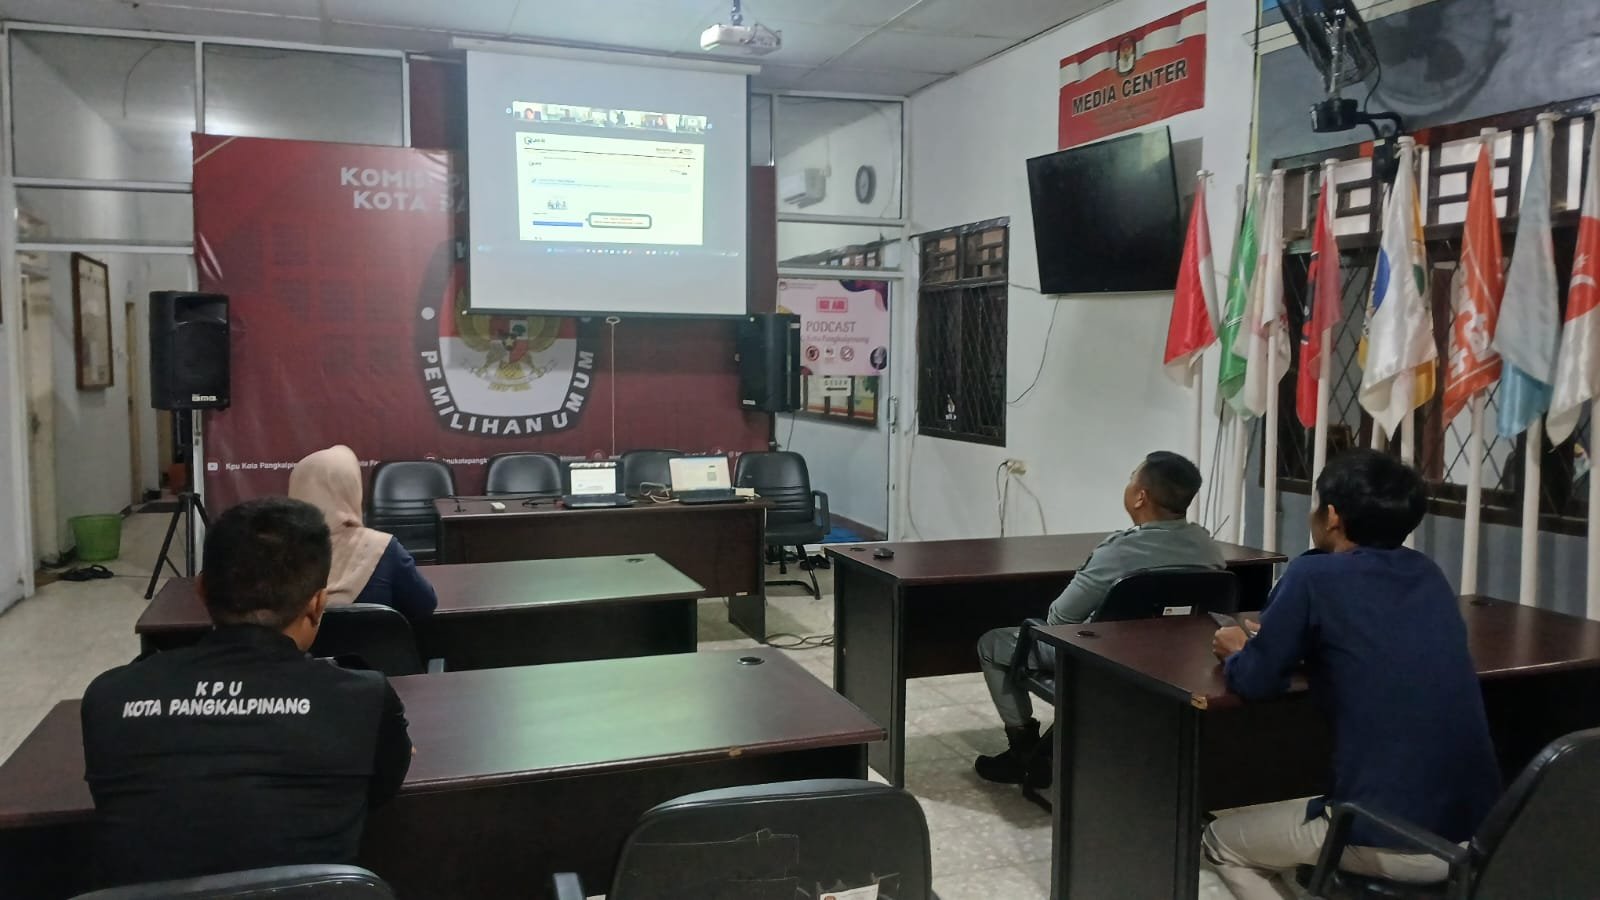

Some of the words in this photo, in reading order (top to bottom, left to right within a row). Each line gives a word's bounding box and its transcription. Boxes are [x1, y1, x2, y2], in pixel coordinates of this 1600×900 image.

[1072, 85, 1117, 117] MEDIA
[1122, 58, 1188, 98] CENTER
[353, 190, 427, 212] KOTA
[805, 321, 857, 333] PODCAST
[421, 350, 543, 435] PEMILIHAN
[551, 350, 595, 429] UMUM
[122, 700, 162, 718] KOTA
[169, 698, 310, 716] PANGKALPINANG
